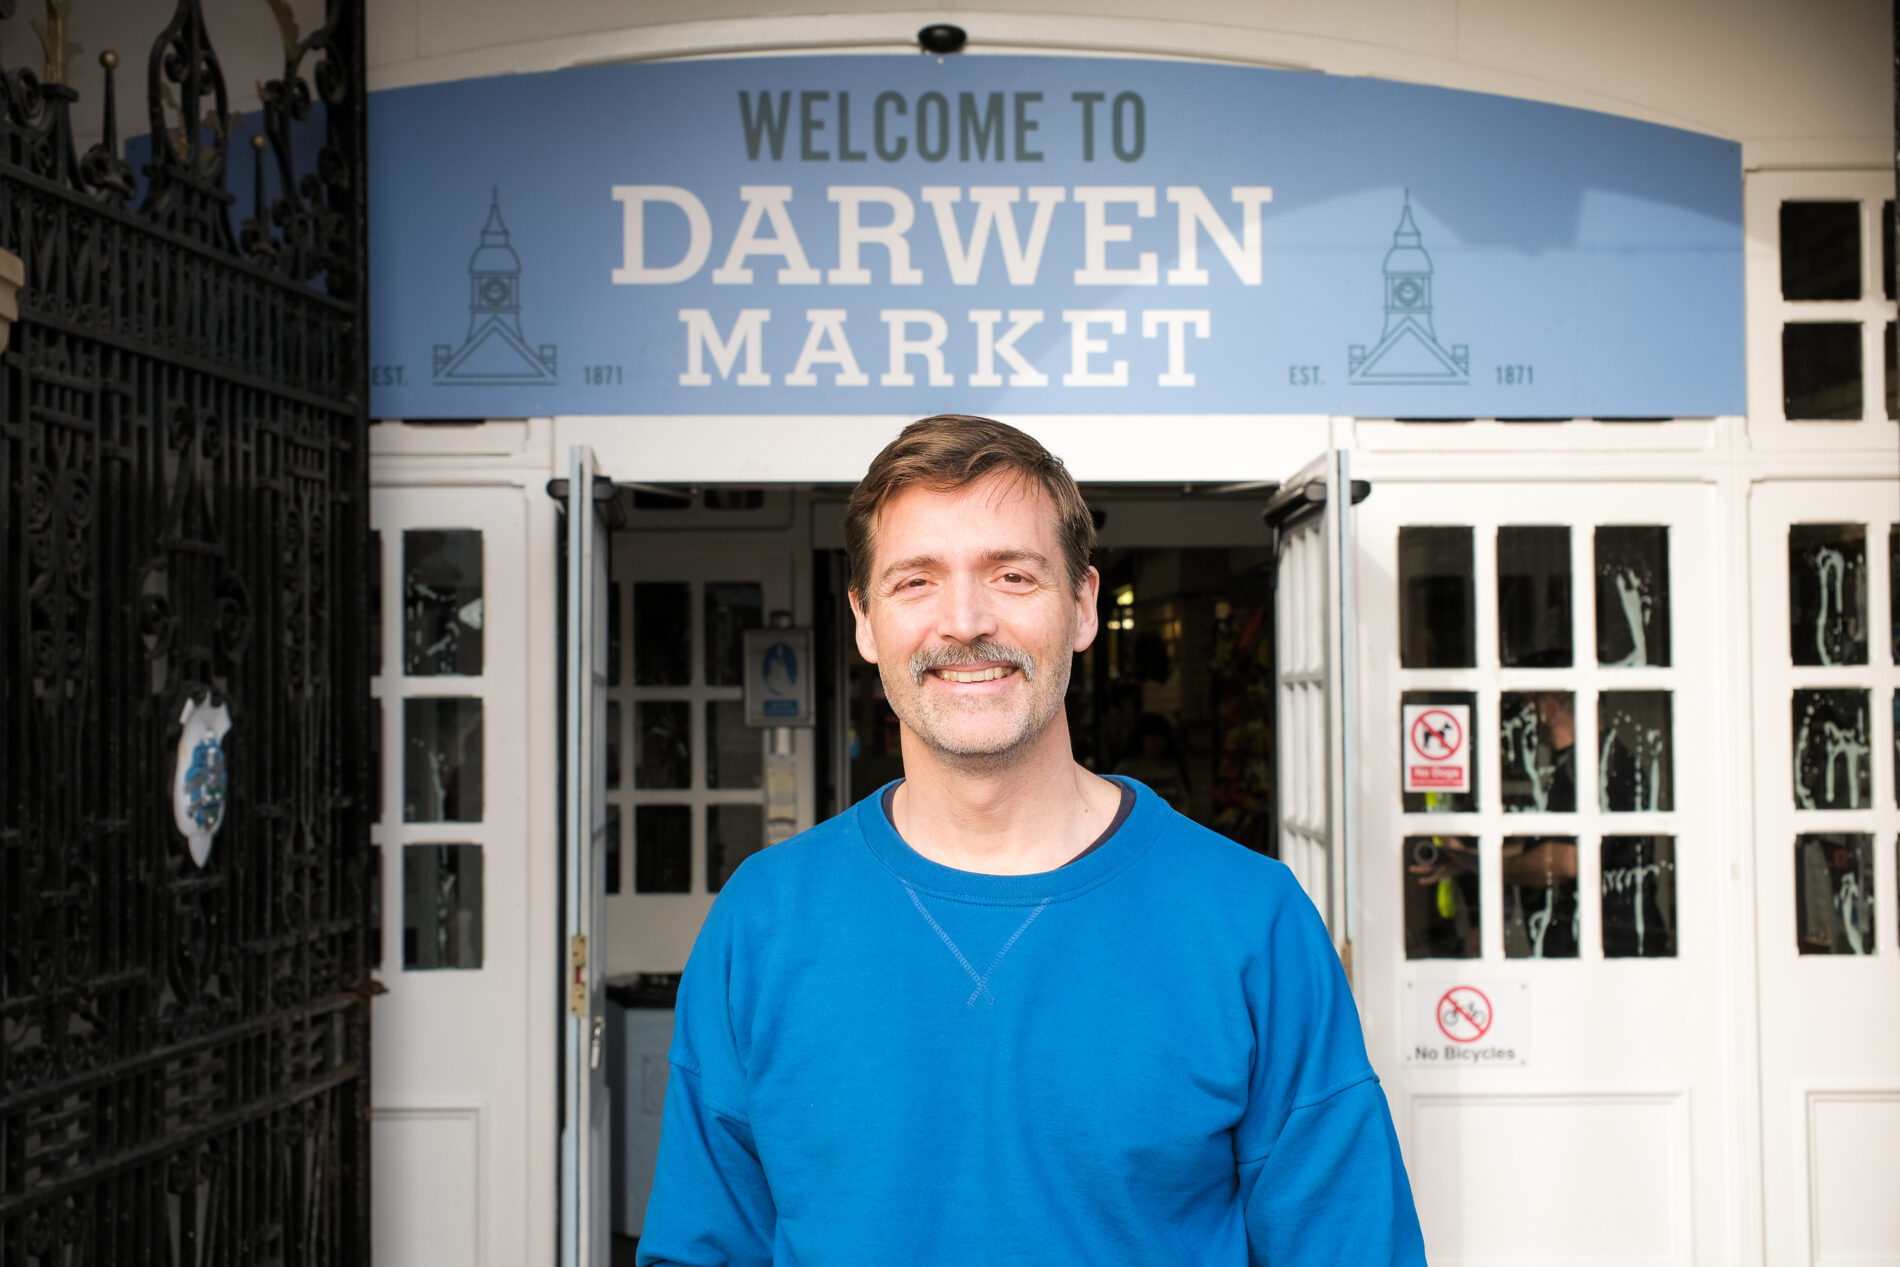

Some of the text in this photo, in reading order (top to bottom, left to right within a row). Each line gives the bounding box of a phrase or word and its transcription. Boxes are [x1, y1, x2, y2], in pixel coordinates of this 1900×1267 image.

[738, 91, 1146, 163] WELCOME TO
[611, 185, 1273, 286] DARWEN
[678, 308, 1210, 387] MARKET
[372, 365, 409, 387] EST.
[583, 365, 623, 386] 1871
[1289, 366, 1325, 386] EST.
[1496, 365, 1534, 385] 1871
[1415, 1045, 1516, 1064] No Bicycles
